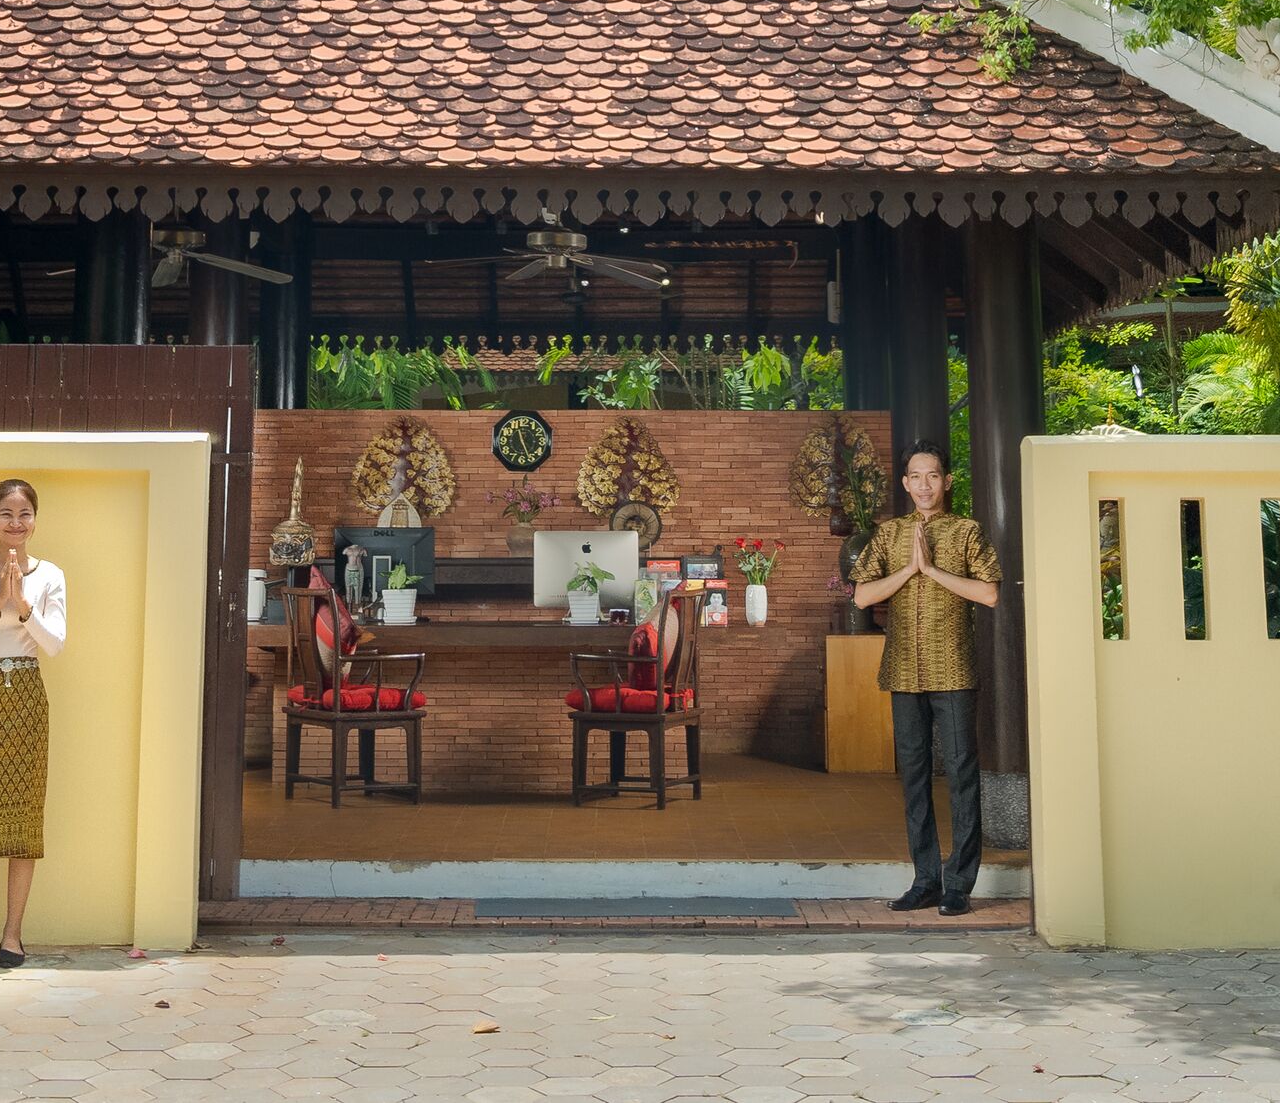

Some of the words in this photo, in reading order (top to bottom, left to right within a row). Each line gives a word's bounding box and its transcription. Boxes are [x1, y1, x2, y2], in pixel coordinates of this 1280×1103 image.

[519, 418, 529, 427] 12
[530, 421, 535, 429] 1
[536, 428, 542, 436] 2
[500, 437, 507, 445] 9
[539, 437, 546, 446] 3
[502, 446, 509, 454] 8
[534, 447, 542, 455] 4
[510, 453, 517, 461] 7
[518, 455, 525, 464] 6
